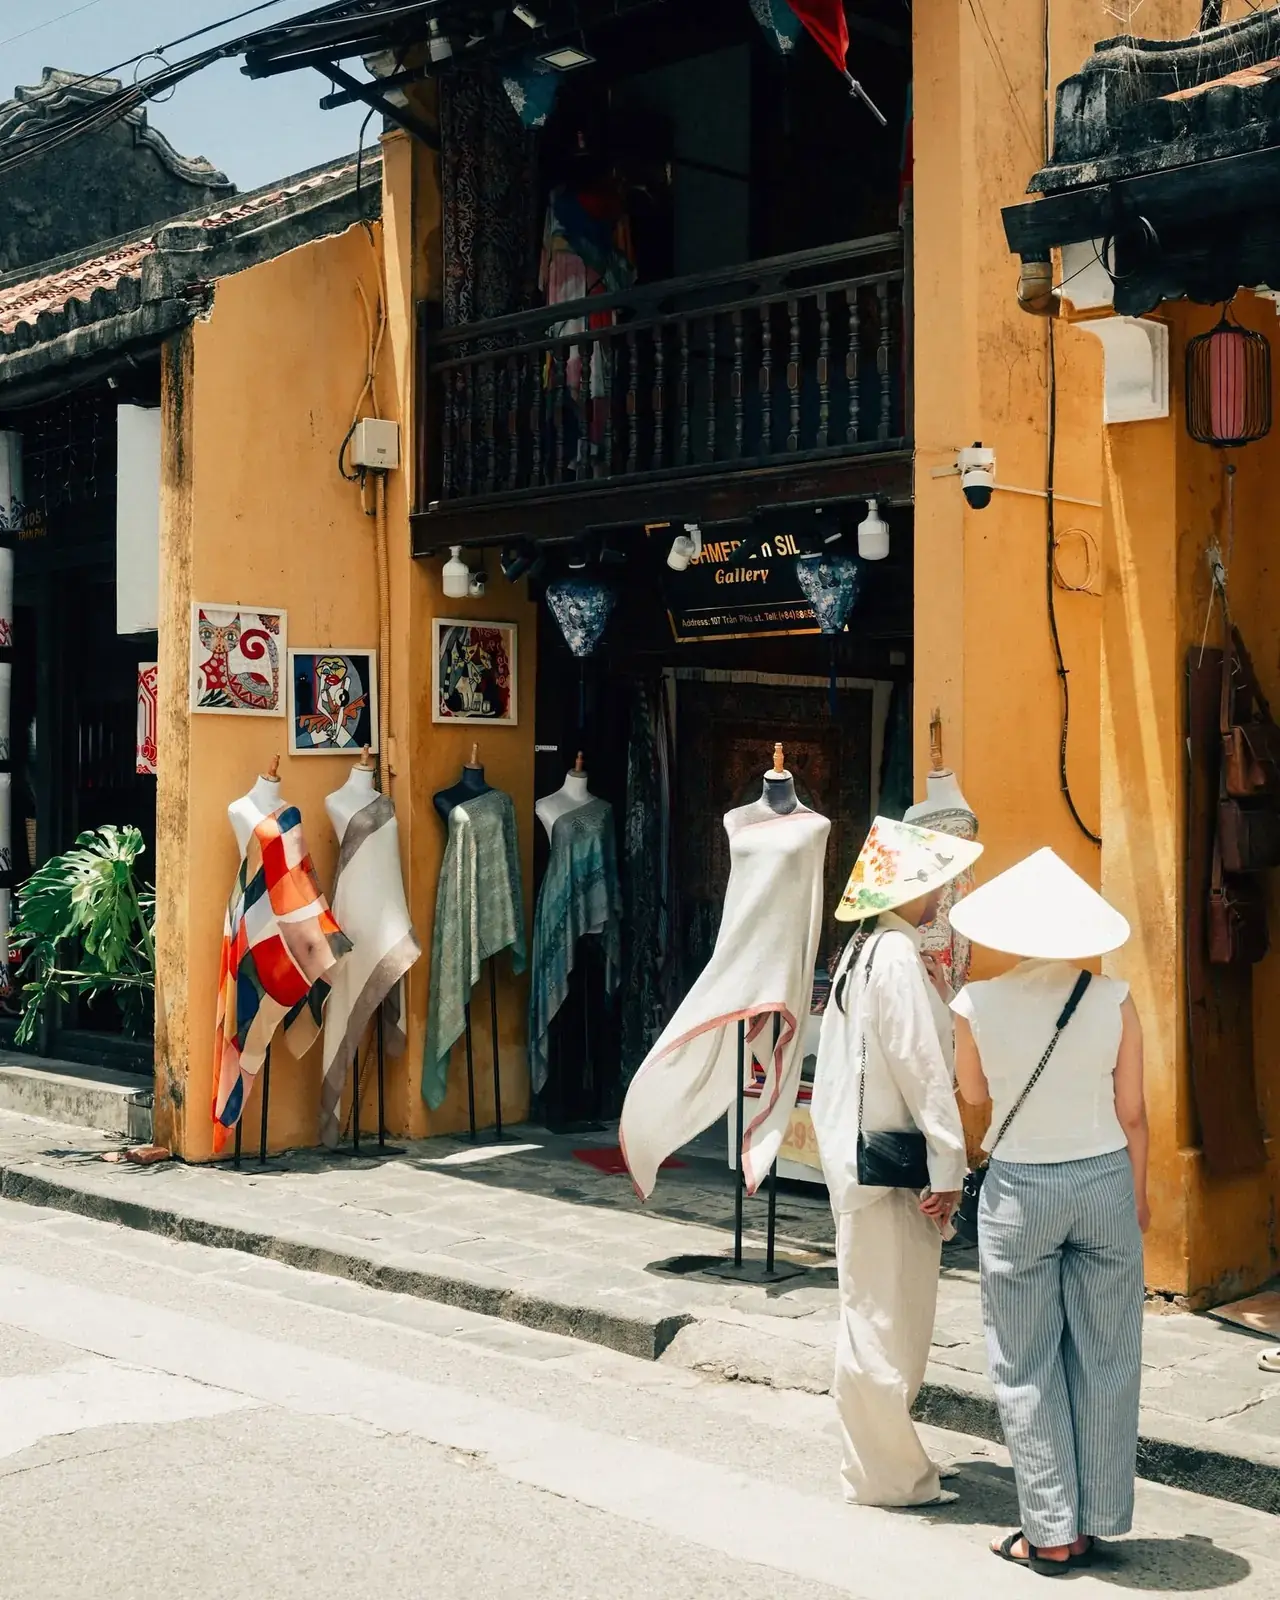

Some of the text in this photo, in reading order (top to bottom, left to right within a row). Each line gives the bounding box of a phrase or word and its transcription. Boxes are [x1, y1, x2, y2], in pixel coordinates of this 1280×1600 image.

[774, 533, 801, 556] SIL
[715, 567, 769, 585] Gallery
[682, 617, 711, 628] Address:
[711, 616, 721, 627] 107
